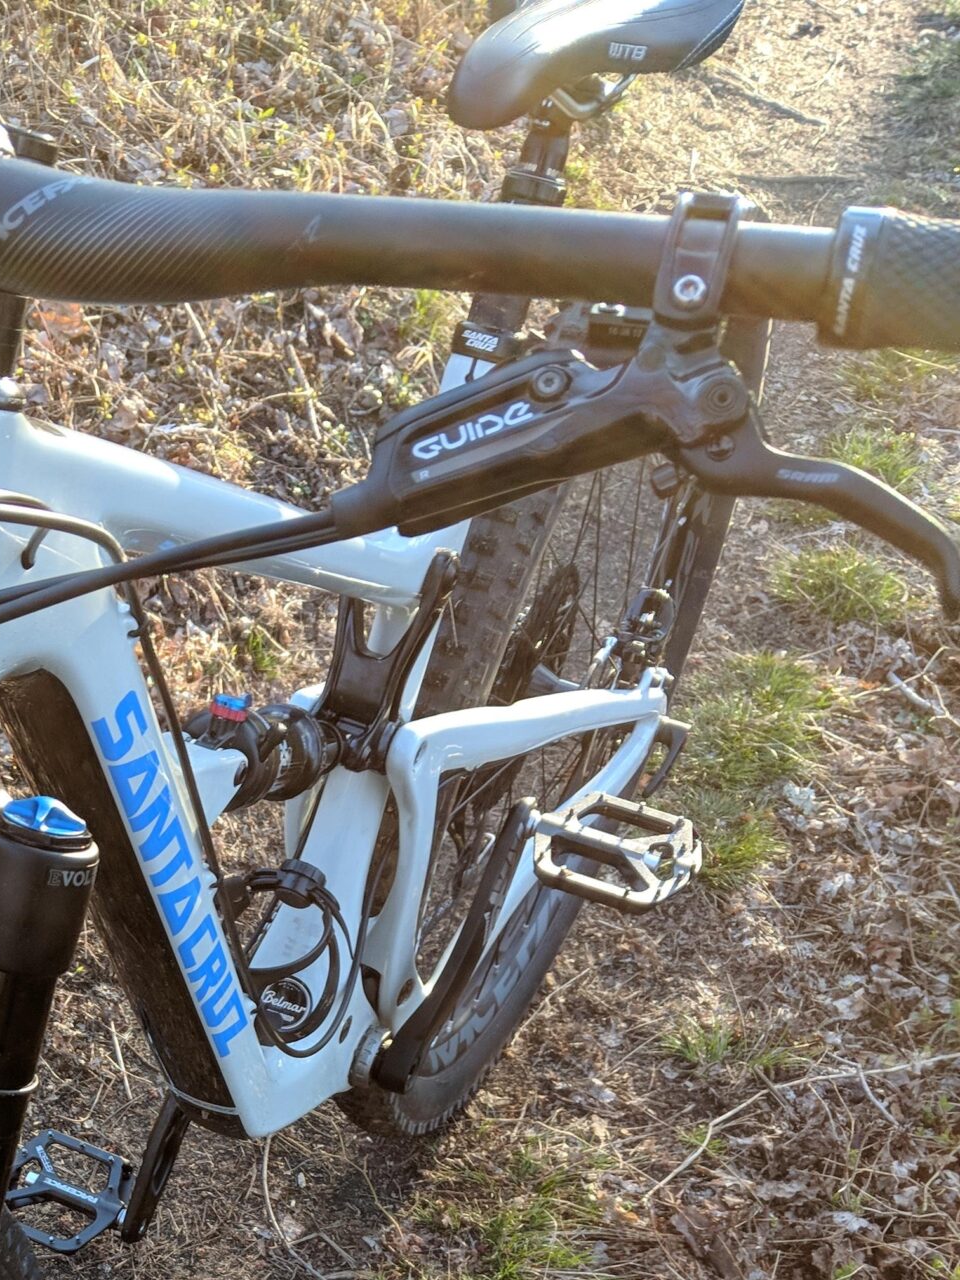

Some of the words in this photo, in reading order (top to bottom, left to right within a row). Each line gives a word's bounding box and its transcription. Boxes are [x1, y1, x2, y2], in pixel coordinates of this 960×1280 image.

[607, 42, 648, 61] WTB
[461, 329, 499, 347] SANTA
[465, 337, 495, 352] CRUZ
[411, 401, 534, 460] GUIDE
[261, 990, 307, 1014] Belmar
